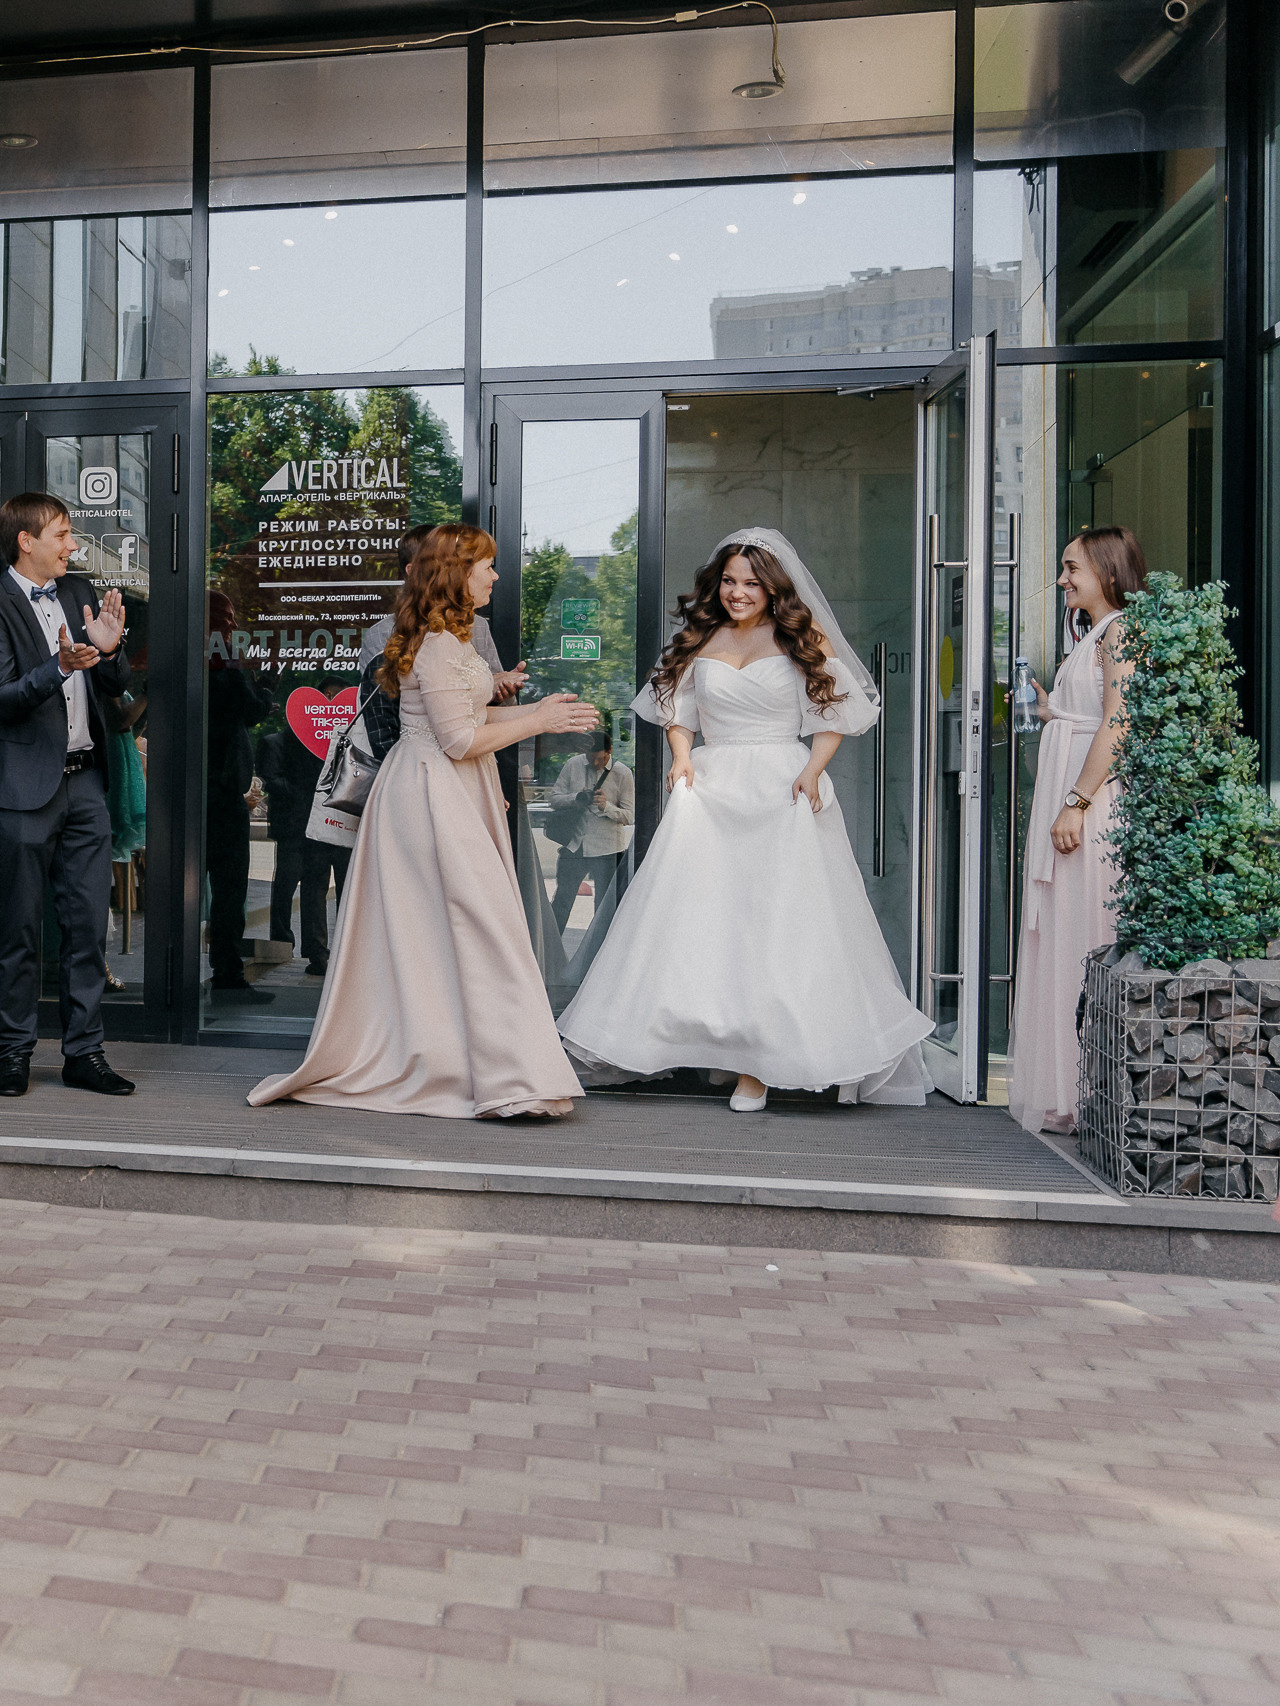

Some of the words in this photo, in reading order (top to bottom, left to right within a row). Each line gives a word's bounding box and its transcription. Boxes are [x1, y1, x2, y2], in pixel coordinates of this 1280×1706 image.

[290, 457, 406, 490] VERTICAL
[259, 493, 331, 503] АПАРТ-ОТЕЛЬ
[334, 491, 406, 501] «ВЕРТИКАЛЬ»
[68, 509, 133, 518] ERTICALHOTEL
[258, 520, 319, 533] РЕЖИМ
[328, 518, 406, 531] РАБОТЫ:
[258, 554, 363, 569] ЕЖЕДНЕВНО
[326, 594, 382, 602] ХОСПИТЕЛИТИ»
[258, 613, 303, 621] Московский
[320, 613, 332, 621] 73,
[208, 628, 370, 660] ARTHOT
[246, 644, 270, 658] Мы
[278, 647, 327, 659] всегда
[261, 662, 271, 671] и
[277, 661, 286, 674] у
[291, 661, 317, 671] нас
[323, 657, 360, 671] безо
